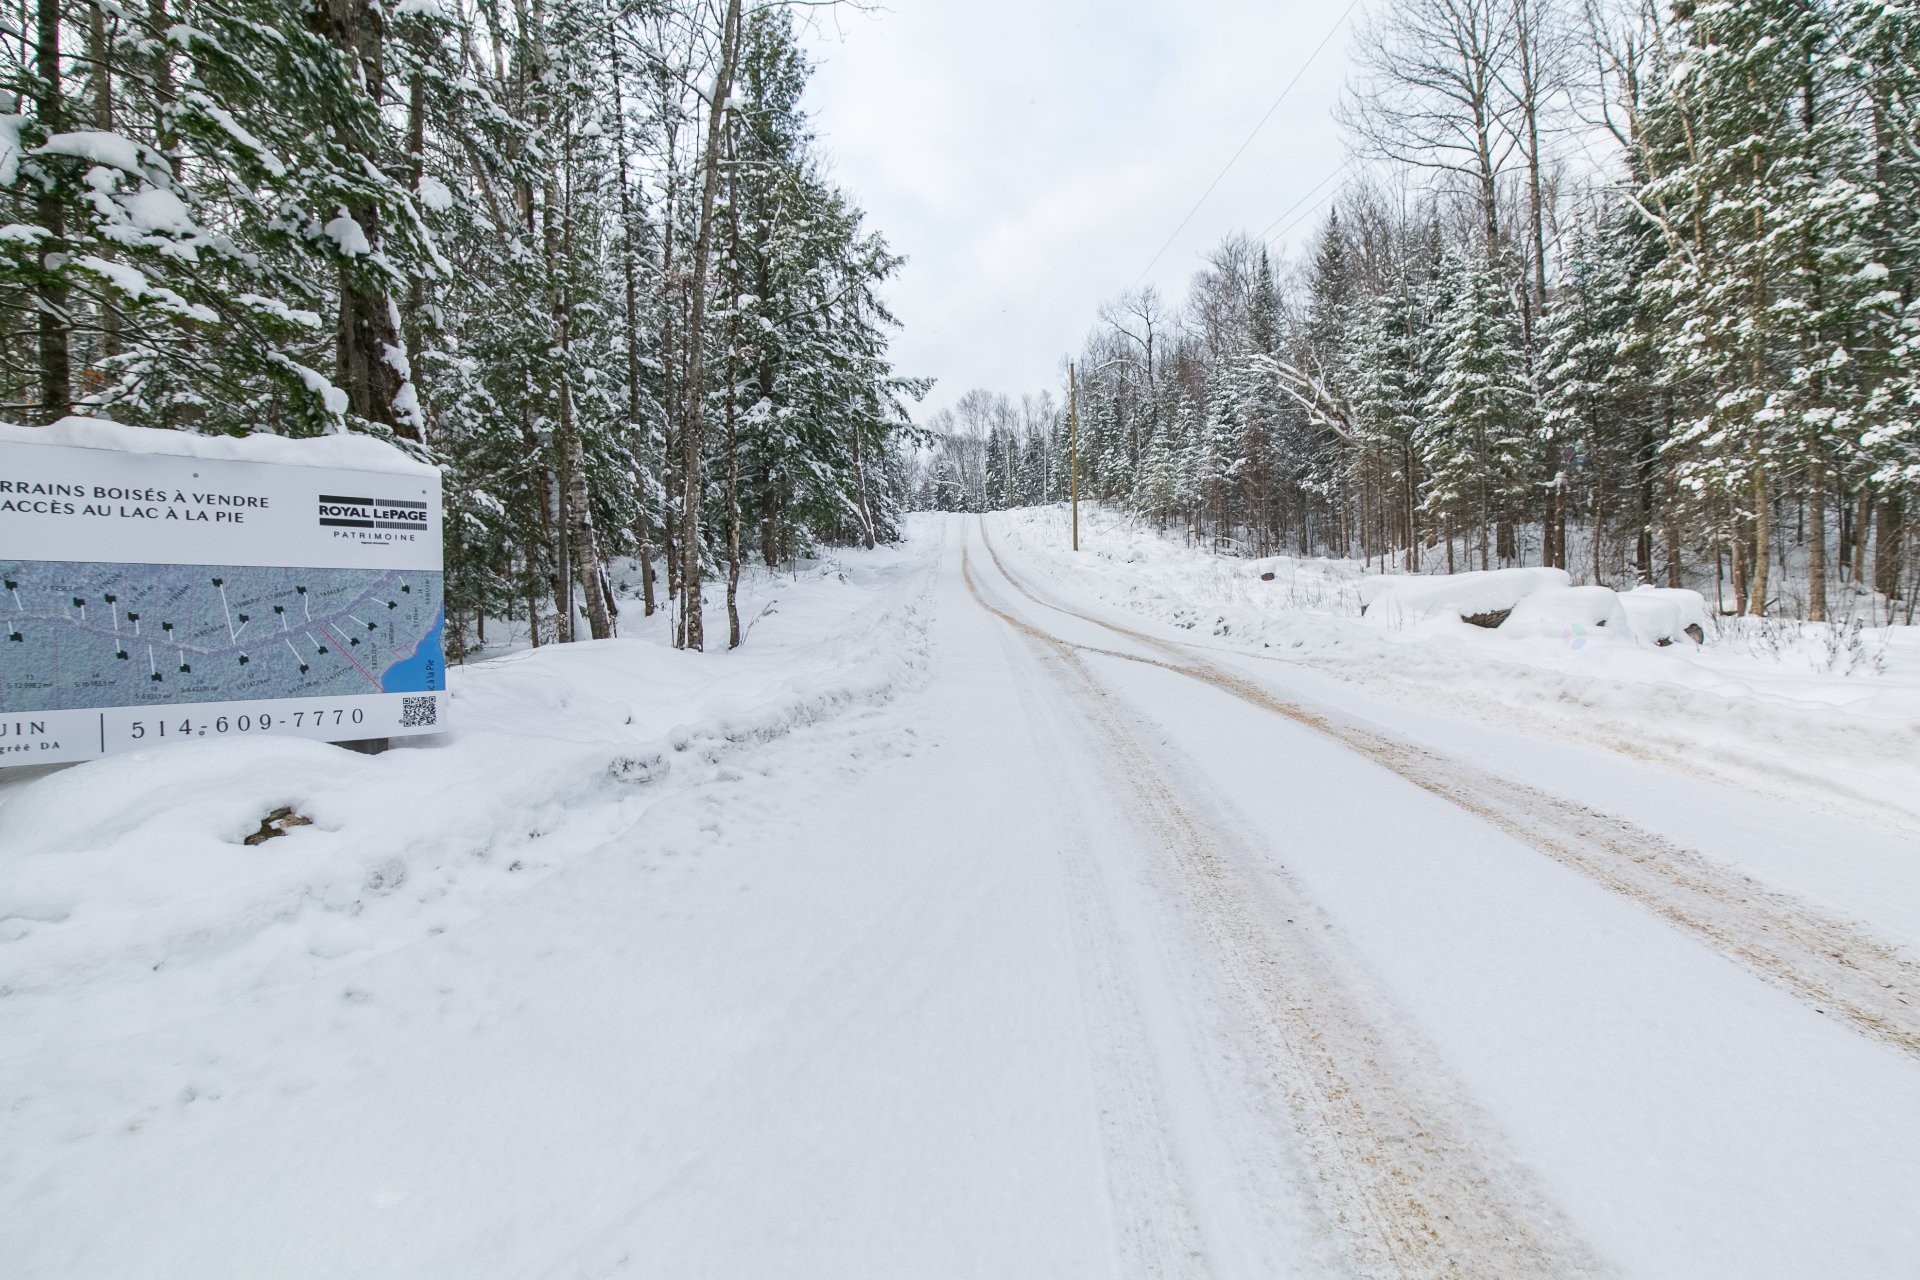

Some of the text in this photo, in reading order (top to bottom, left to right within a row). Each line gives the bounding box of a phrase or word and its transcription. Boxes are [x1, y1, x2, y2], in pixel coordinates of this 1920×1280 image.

[93, 486, 167, 503] BOISÉS
[174, 489, 187, 504] À
[193, 492, 270, 509] VENDRE
[0, 499, 245, 524] ACCÈS AU LAC À LA PIE
[319, 505, 371, 519] ROYAL
[333, 531, 416, 542] PATRIMOINE
[131, 707, 365, 740] 514-609-7770
[40, 741, 60, 750] DA
